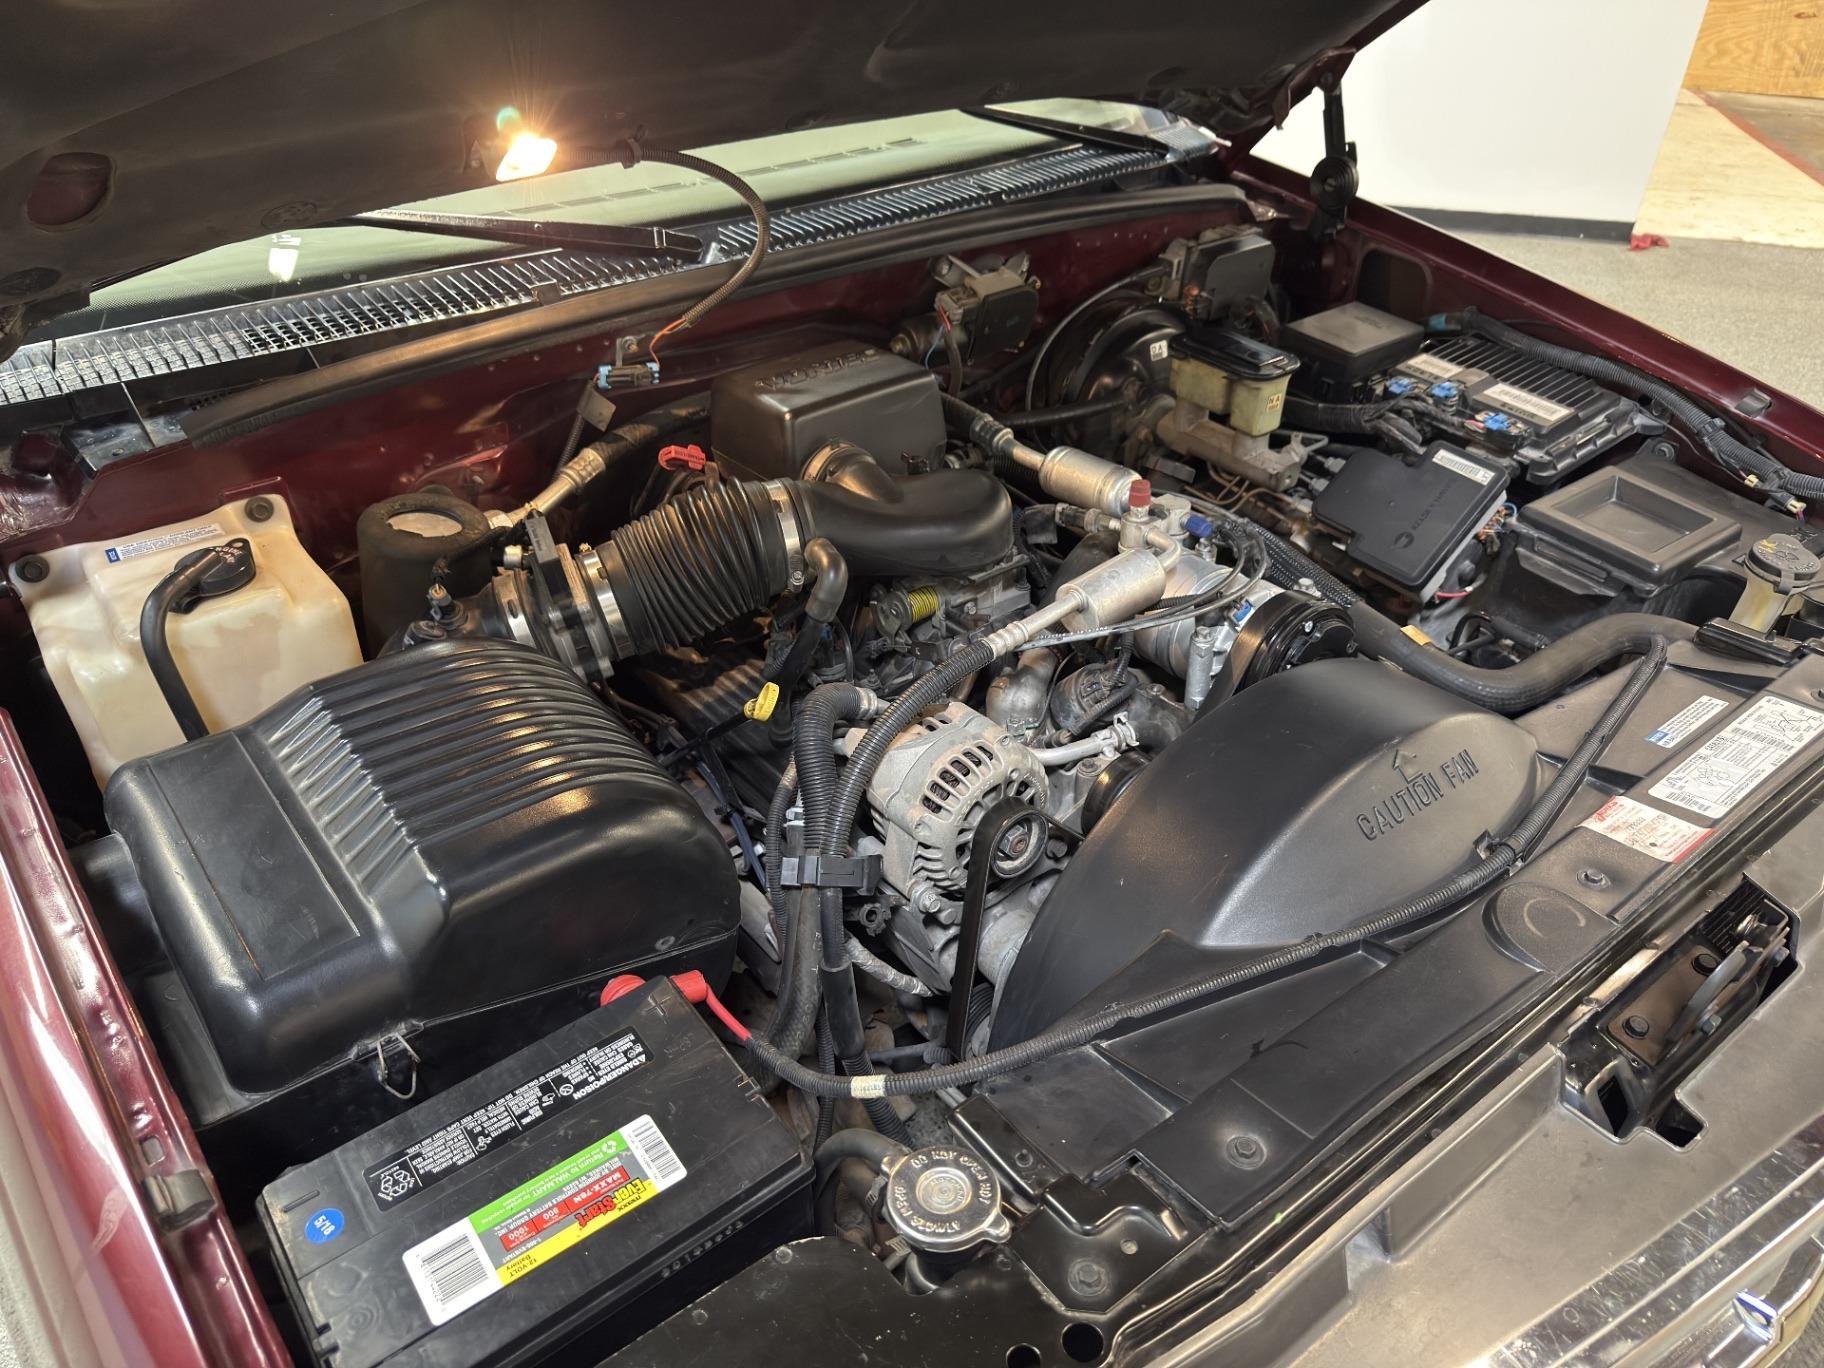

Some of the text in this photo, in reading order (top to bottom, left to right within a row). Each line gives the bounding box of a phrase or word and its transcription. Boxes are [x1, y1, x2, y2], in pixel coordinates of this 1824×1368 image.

[1356, 749, 1479, 841] CAUTION FAN
[571, 1057, 640, 1100] DANGER/POISON
[578, 1151, 604, 1169] Return
[910, 1154, 929, 1169] DO
[531, 1170, 570, 1196] WALMART
[542, 1206, 559, 1220] 800
[507, 1224, 528, 1240] 1000
[505, 1253, 530, 1271] Battery
